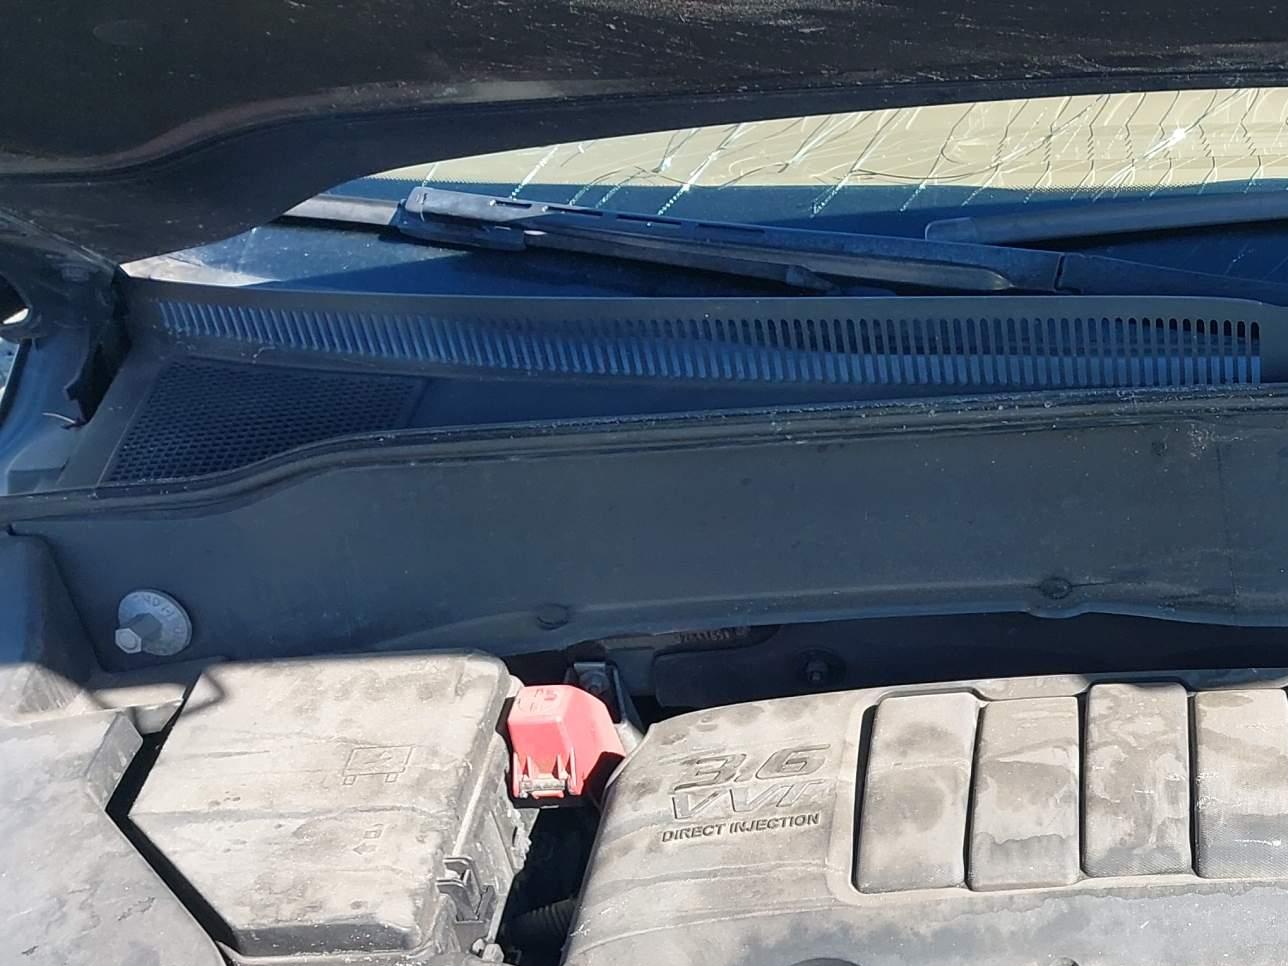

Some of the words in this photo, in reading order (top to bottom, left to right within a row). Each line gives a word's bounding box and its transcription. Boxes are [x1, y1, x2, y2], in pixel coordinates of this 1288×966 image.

[672, 744, 831, 789] 3.6
[671, 780, 826, 821] VVT
[662, 822, 726, 843] DIRECT
[729, 812, 820, 835] INJECTION
